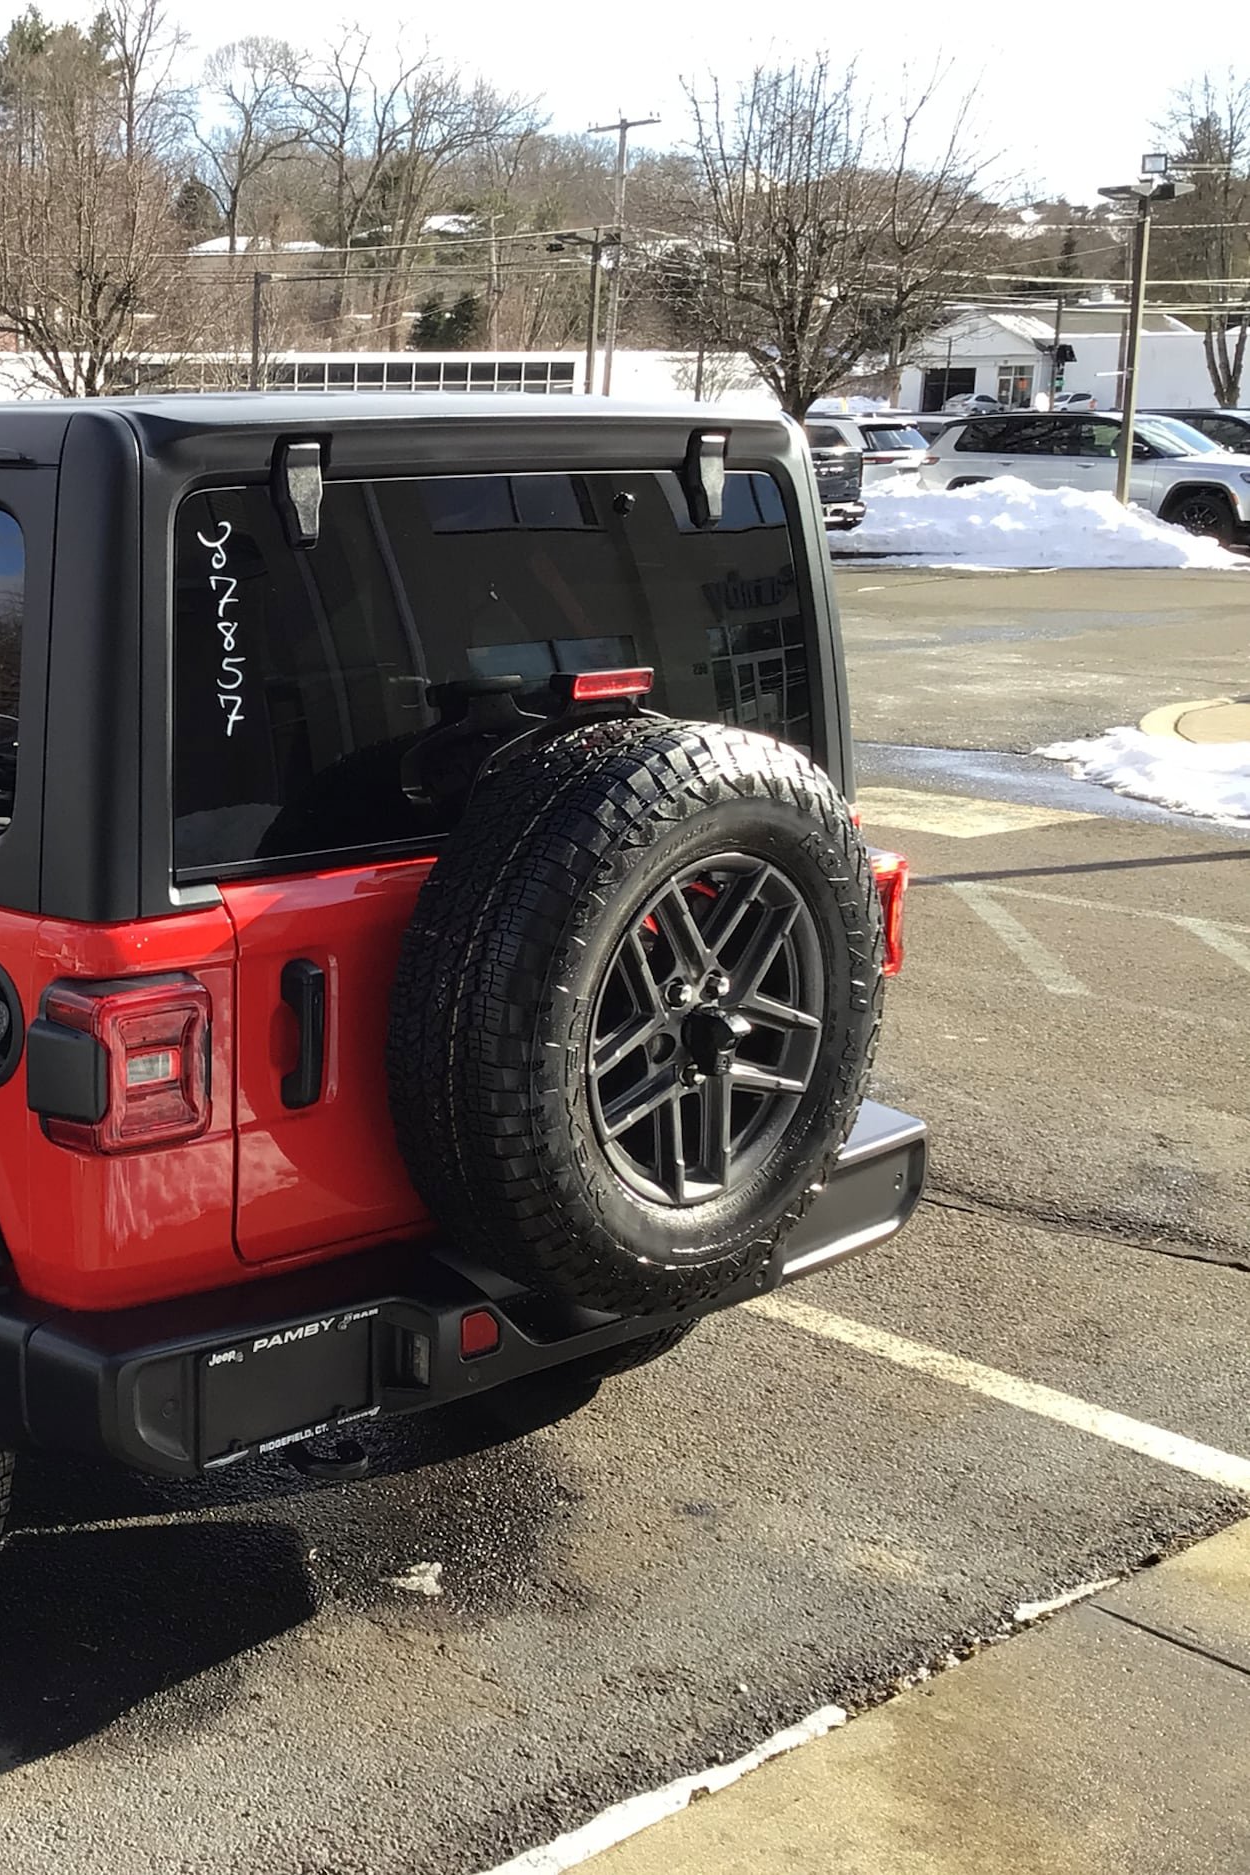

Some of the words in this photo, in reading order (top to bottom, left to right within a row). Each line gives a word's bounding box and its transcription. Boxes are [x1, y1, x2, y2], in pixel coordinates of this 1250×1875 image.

[208, 1350, 236, 1366] Jeep
[253, 1317, 336, 1353] PAMBY
[352, 1308, 379, 1321] RAM
